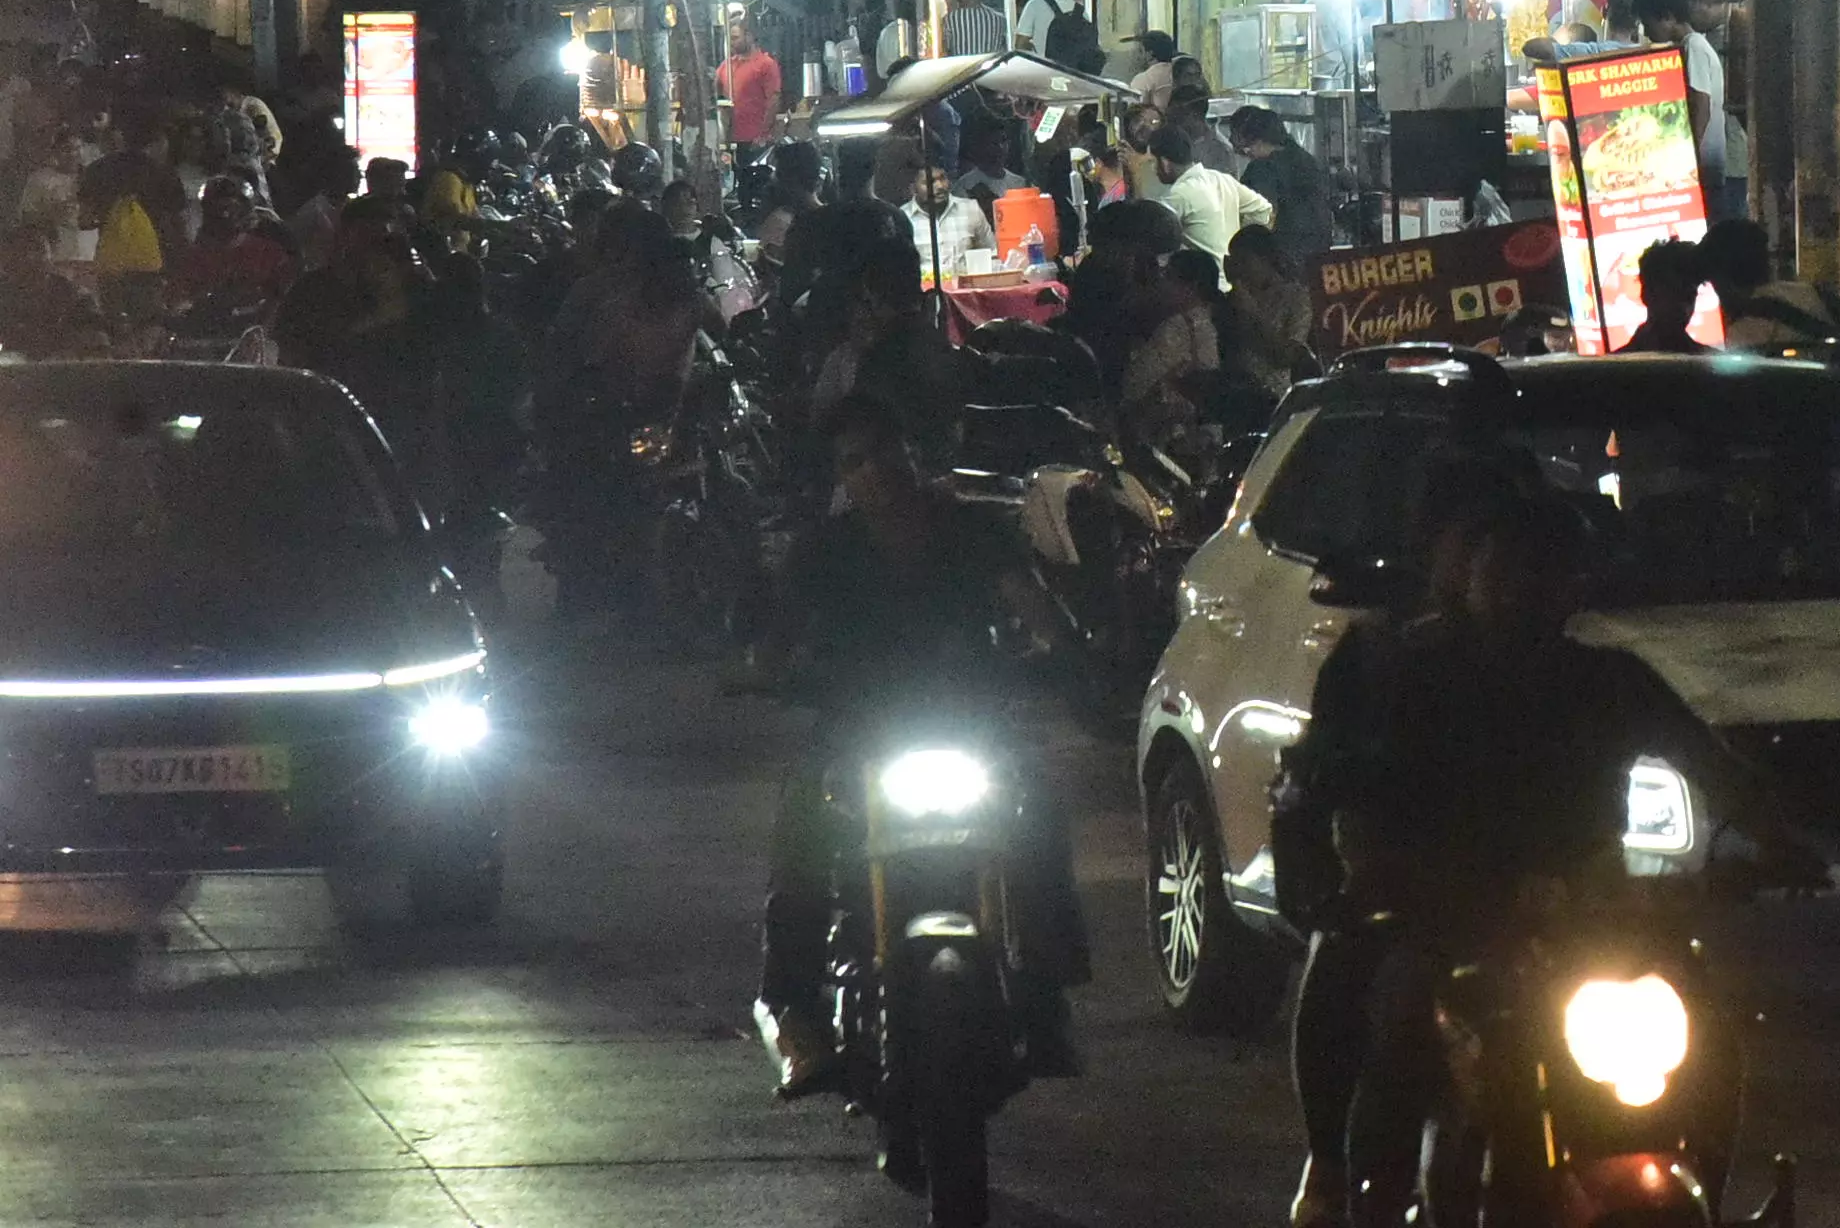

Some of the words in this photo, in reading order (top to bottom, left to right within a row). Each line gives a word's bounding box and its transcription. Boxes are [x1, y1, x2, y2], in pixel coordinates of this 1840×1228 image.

[1568, 69, 1598, 85] SRK
[1599, 54, 1684, 82] SHAWARMA
[1599, 76, 1658, 99] MAGGIE
[1321, 248, 1435, 295] BURGER
[1322, 289, 1438, 348] Knights
